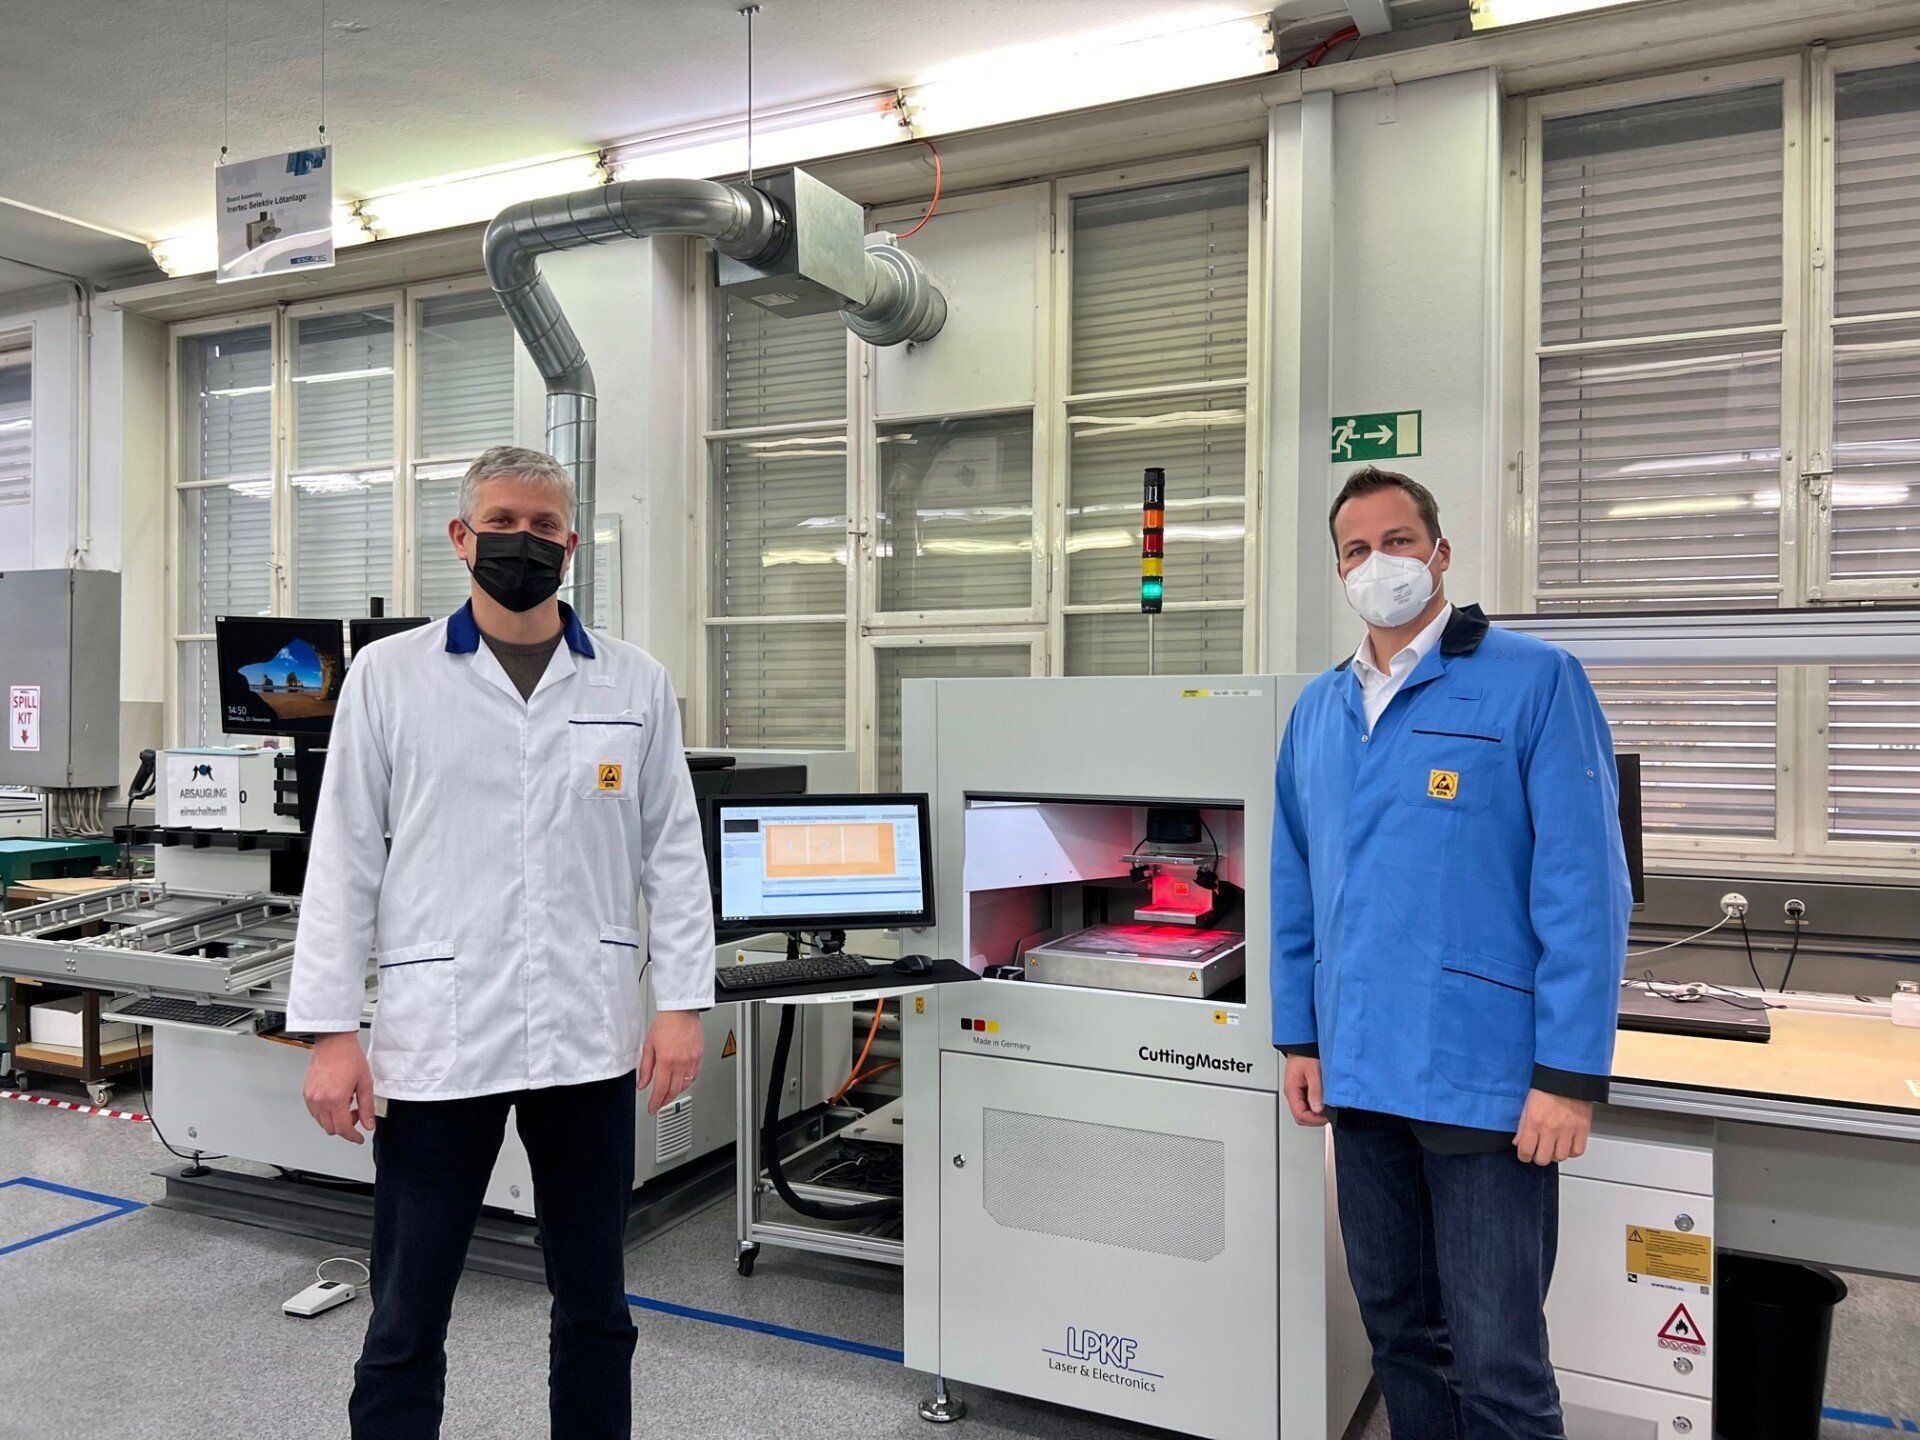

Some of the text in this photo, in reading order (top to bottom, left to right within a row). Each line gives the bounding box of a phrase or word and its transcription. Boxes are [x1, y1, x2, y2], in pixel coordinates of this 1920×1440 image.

[226, 204, 247, 213] Inertec
[248, 199, 274, 210] Selektiv
[13, 696, 37, 708] SPILL
[228, 706, 247, 715] 14:50
[18, 712, 32, 724] KIT
[179, 788, 228, 799] ABSAUGUNG
[973, 1037, 991, 1046] Made
[1000, 1040, 1031, 1052] Germany
[1138, 1046, 1254, 1073] CuttingMaster
[1067, 1326, 1138, 1369] LPKF
[1048, 1357, 1156, 1392] Laser & Electronics
